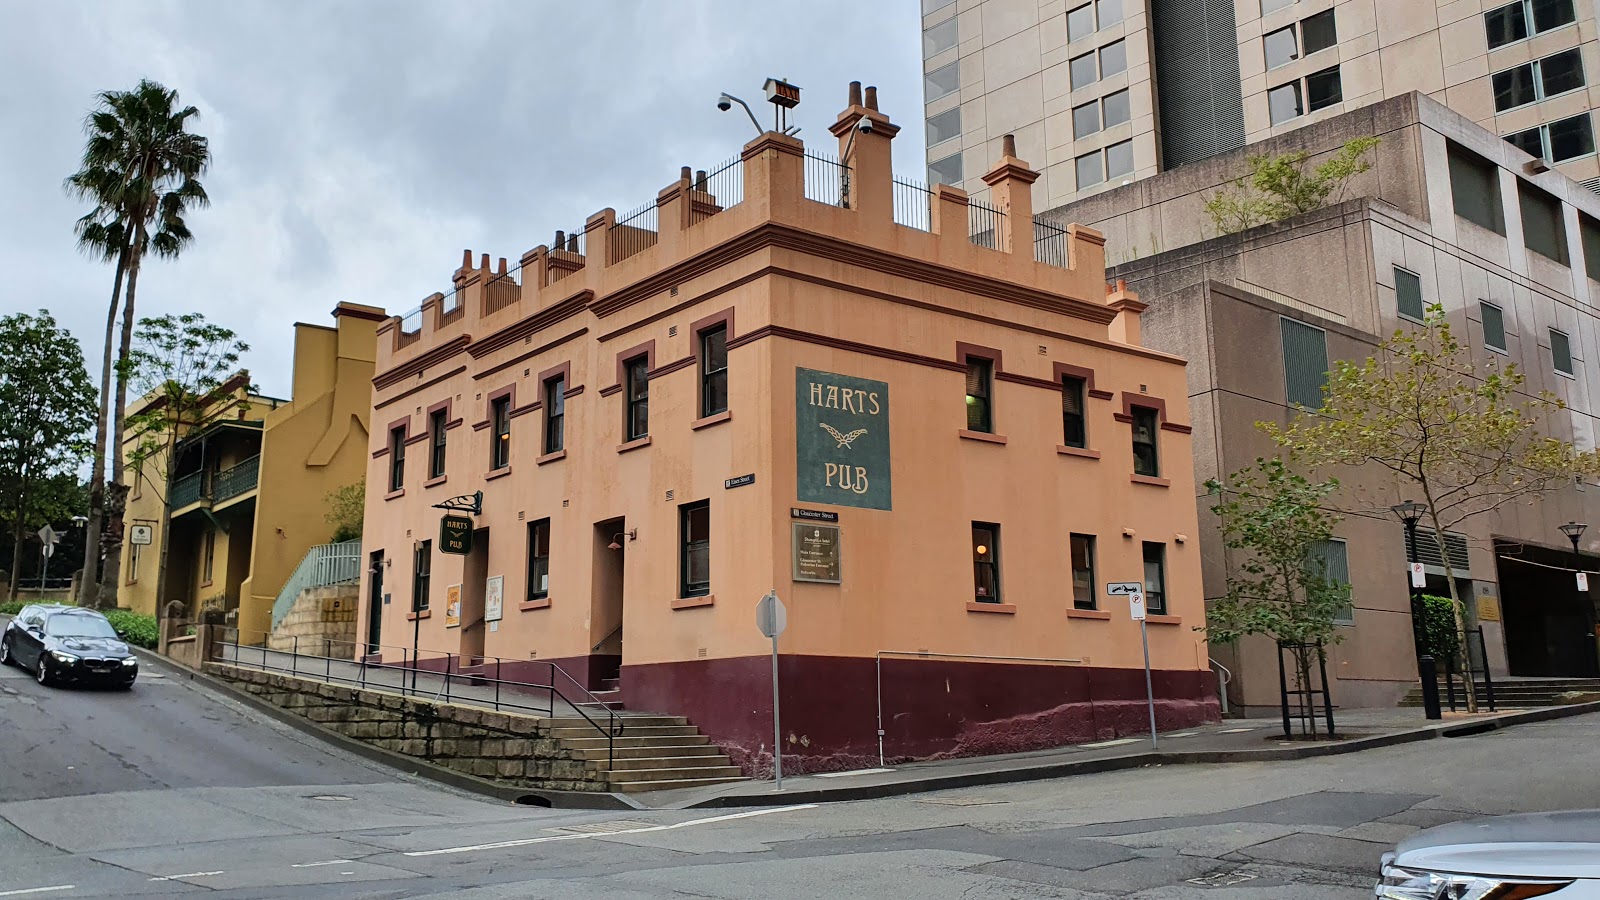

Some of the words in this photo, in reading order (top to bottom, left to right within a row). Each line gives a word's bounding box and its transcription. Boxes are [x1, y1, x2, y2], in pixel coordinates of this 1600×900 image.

[776, 84, 800, 101] TAXI
[809, 382, 880, 415] HARTS
[824, 462, 869, 494] PUB
[800, 510, 821, 518] Gloucester
[447, 521, 468, 529] HARTS
[450, 540, 463, 549] PUB
